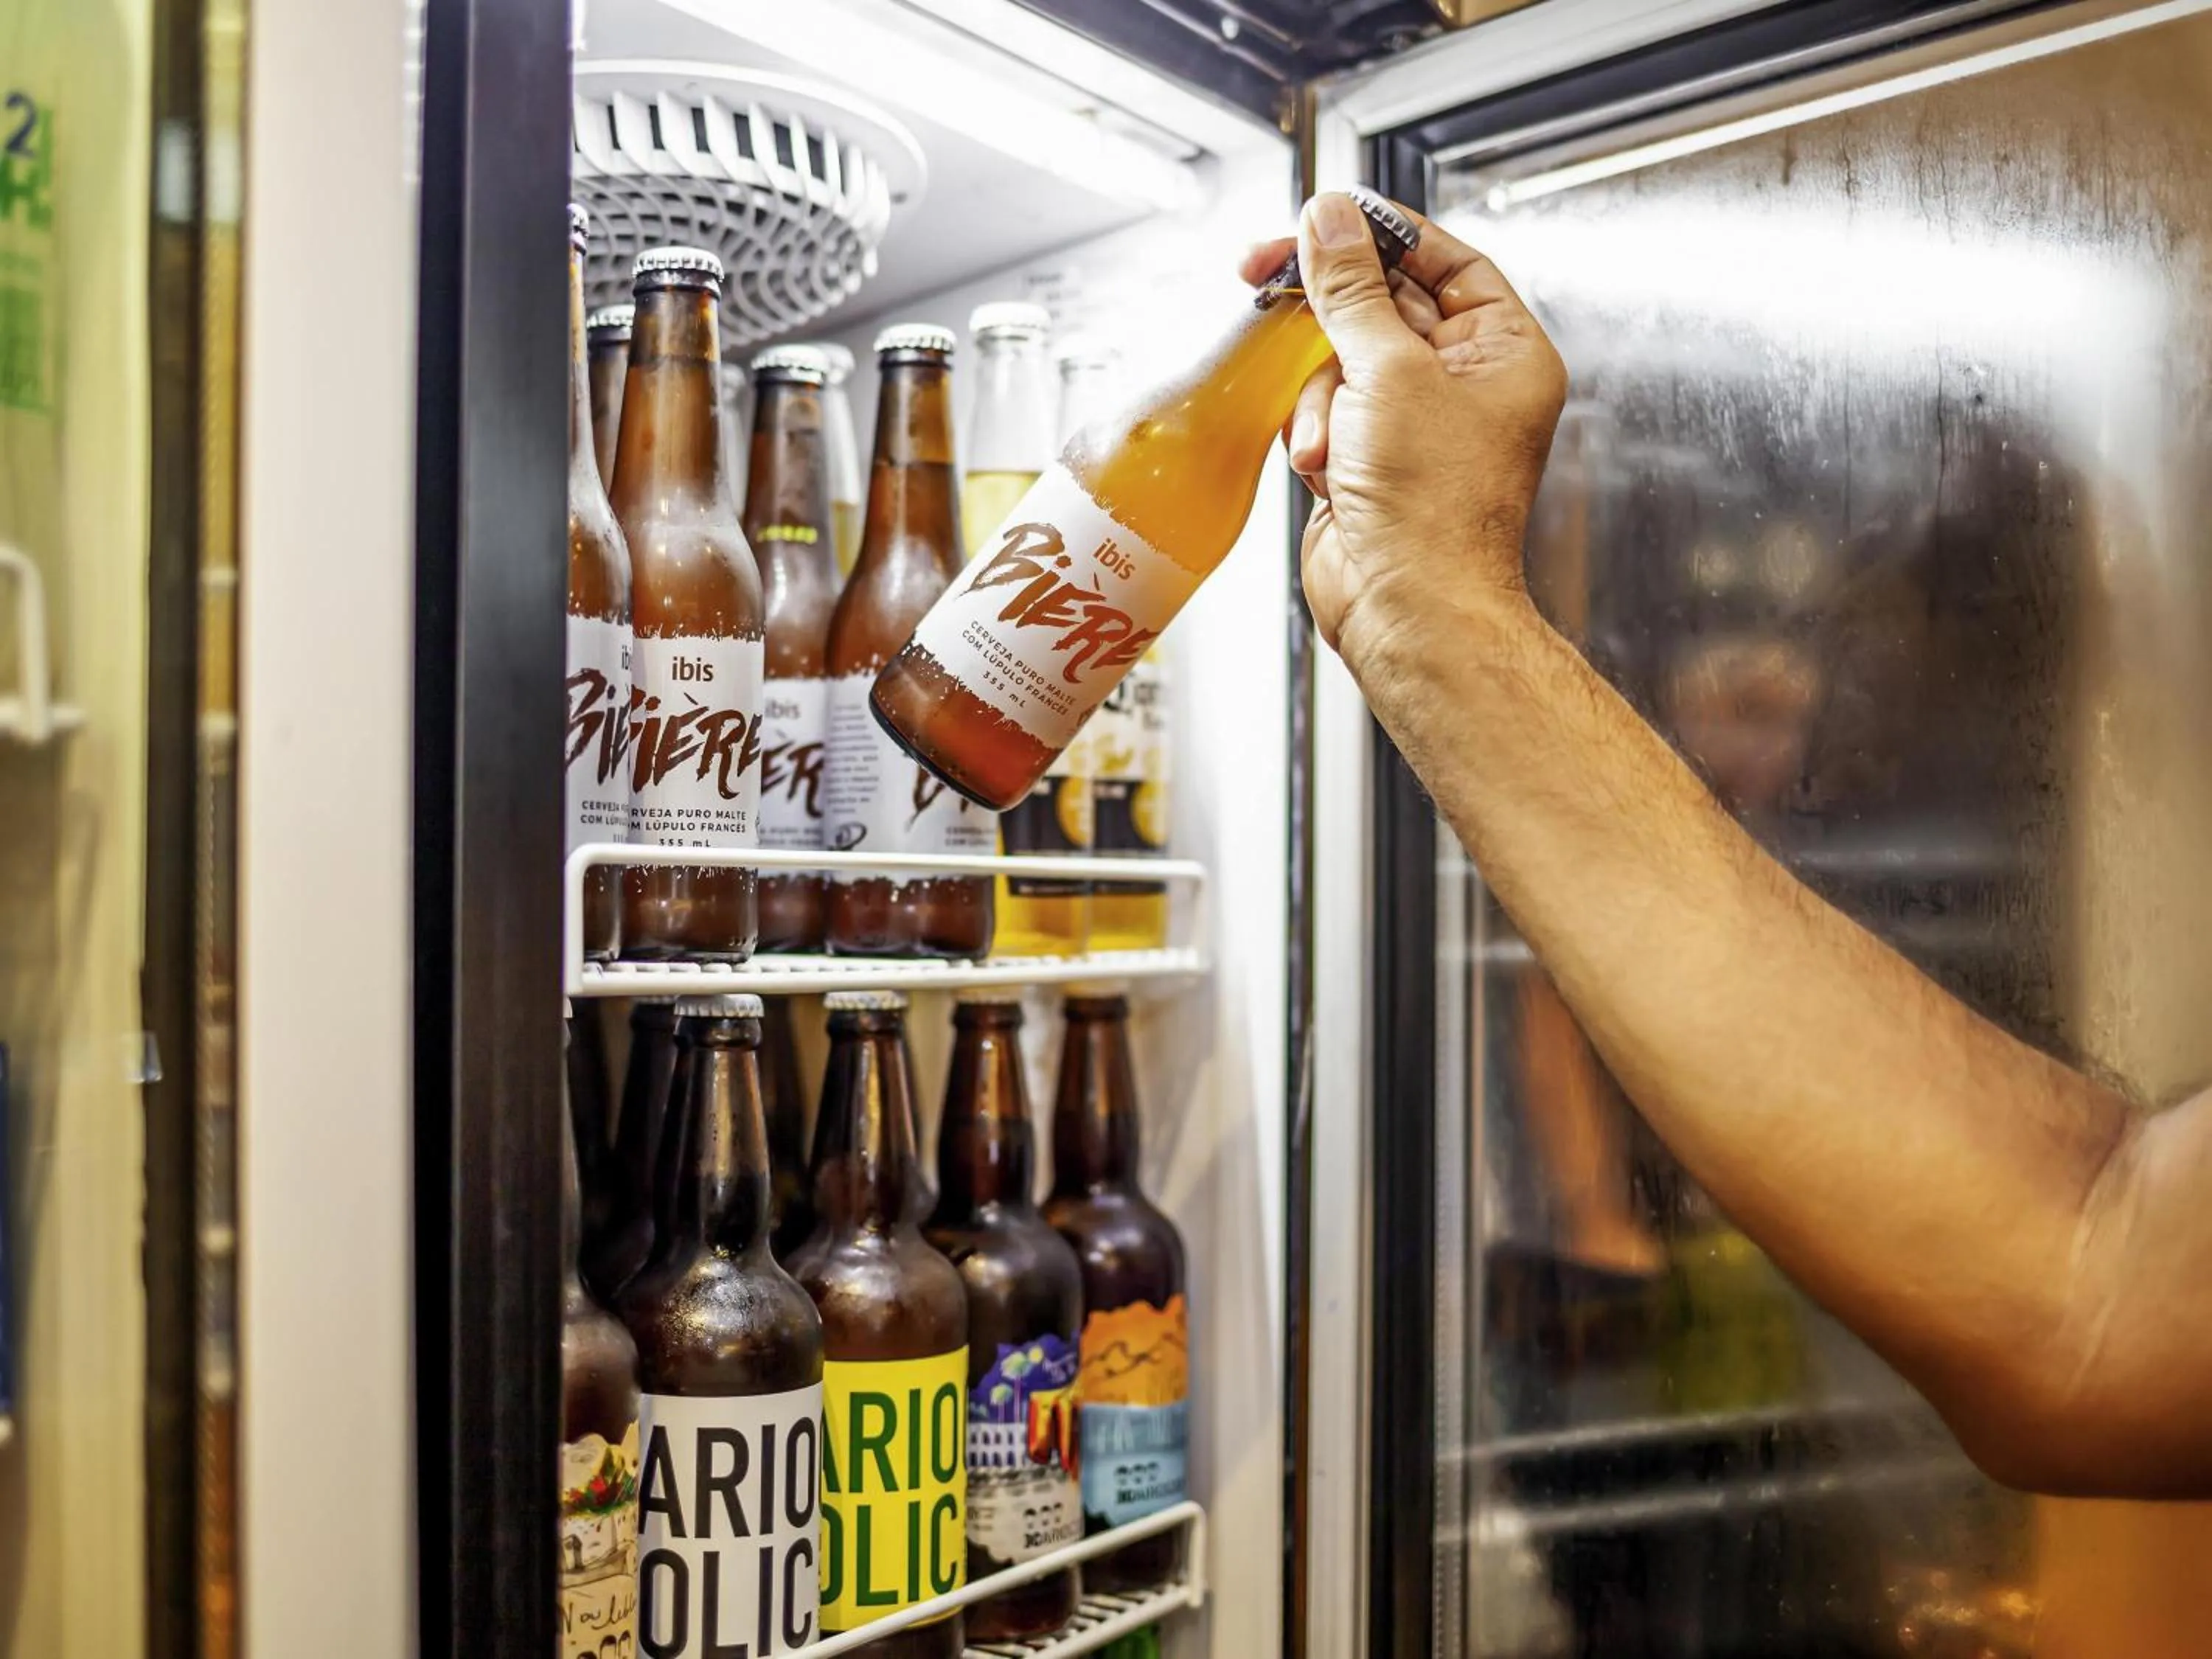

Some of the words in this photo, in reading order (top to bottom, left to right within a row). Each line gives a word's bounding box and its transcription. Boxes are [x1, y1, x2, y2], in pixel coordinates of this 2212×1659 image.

[1093, 538, 1136, 580] ibis
[672, 656, 714, 682] ibis
[962, 630, 983, 651] COM
[983, 650, 1024, 685] LÚPULO
[970, 620, 1013, 661] CERVEJA
[1015, 660, 1045, 685] PURO
[1045, 684, 1077, 706] MALTE
[983, 670, 1006, 691] 355
[631, 808, 672, 818] RVEJA
[678, 810, 712, 819] PURO
[716, 810, 747, 821] MALTE
[645, 819, 696, 832] LÚPULO
